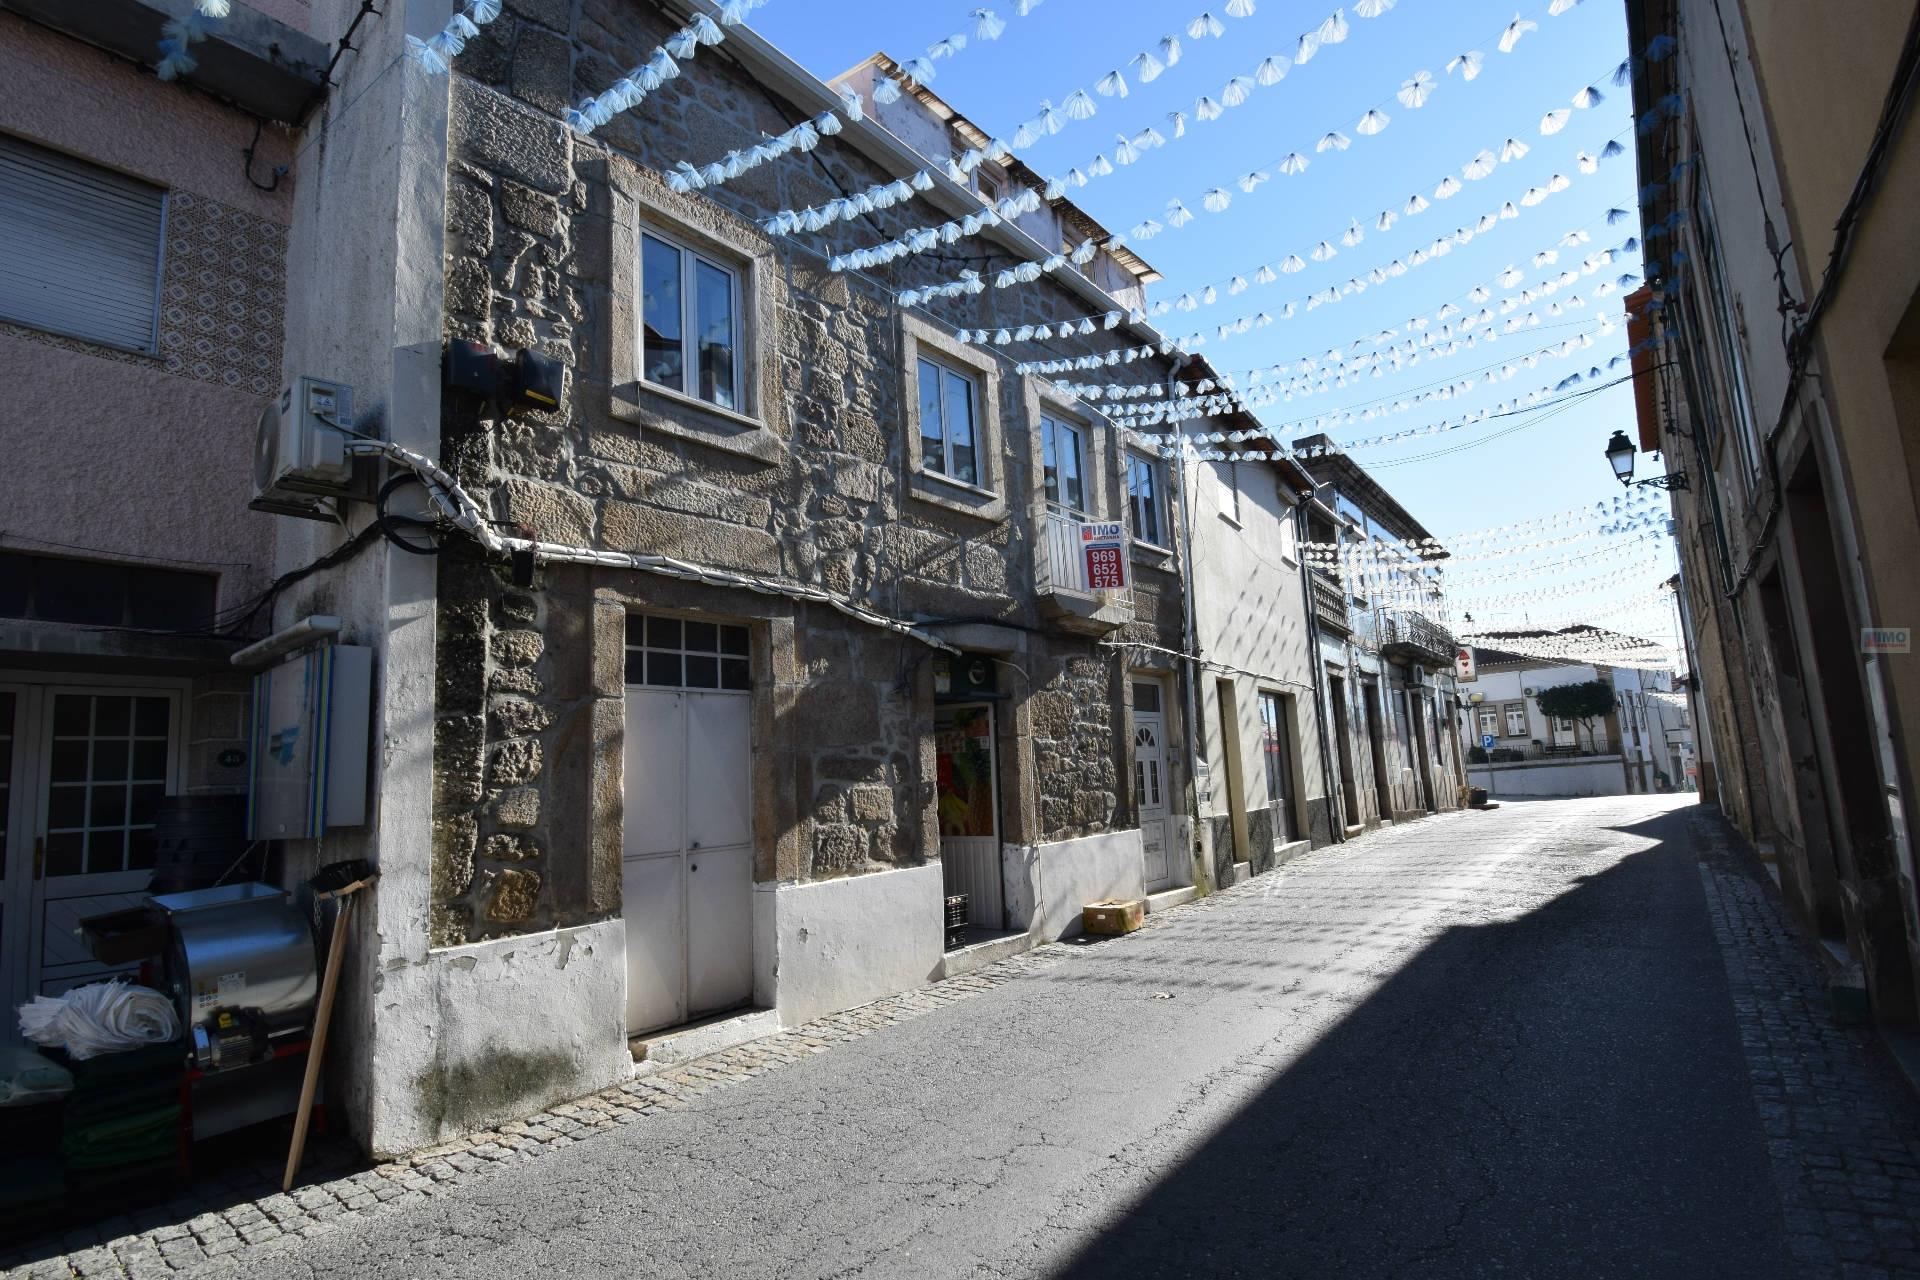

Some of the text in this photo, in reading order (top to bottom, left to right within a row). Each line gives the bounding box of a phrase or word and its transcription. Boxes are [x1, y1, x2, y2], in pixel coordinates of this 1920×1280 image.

[1092, 524, 1120, 536] IMO
[1092, 551, 1116, 563] 969
[1093, 563, 1118, 576] 652
[1095, 576, 1119, 588] 575
[1484, 736, 1492, 746] P
